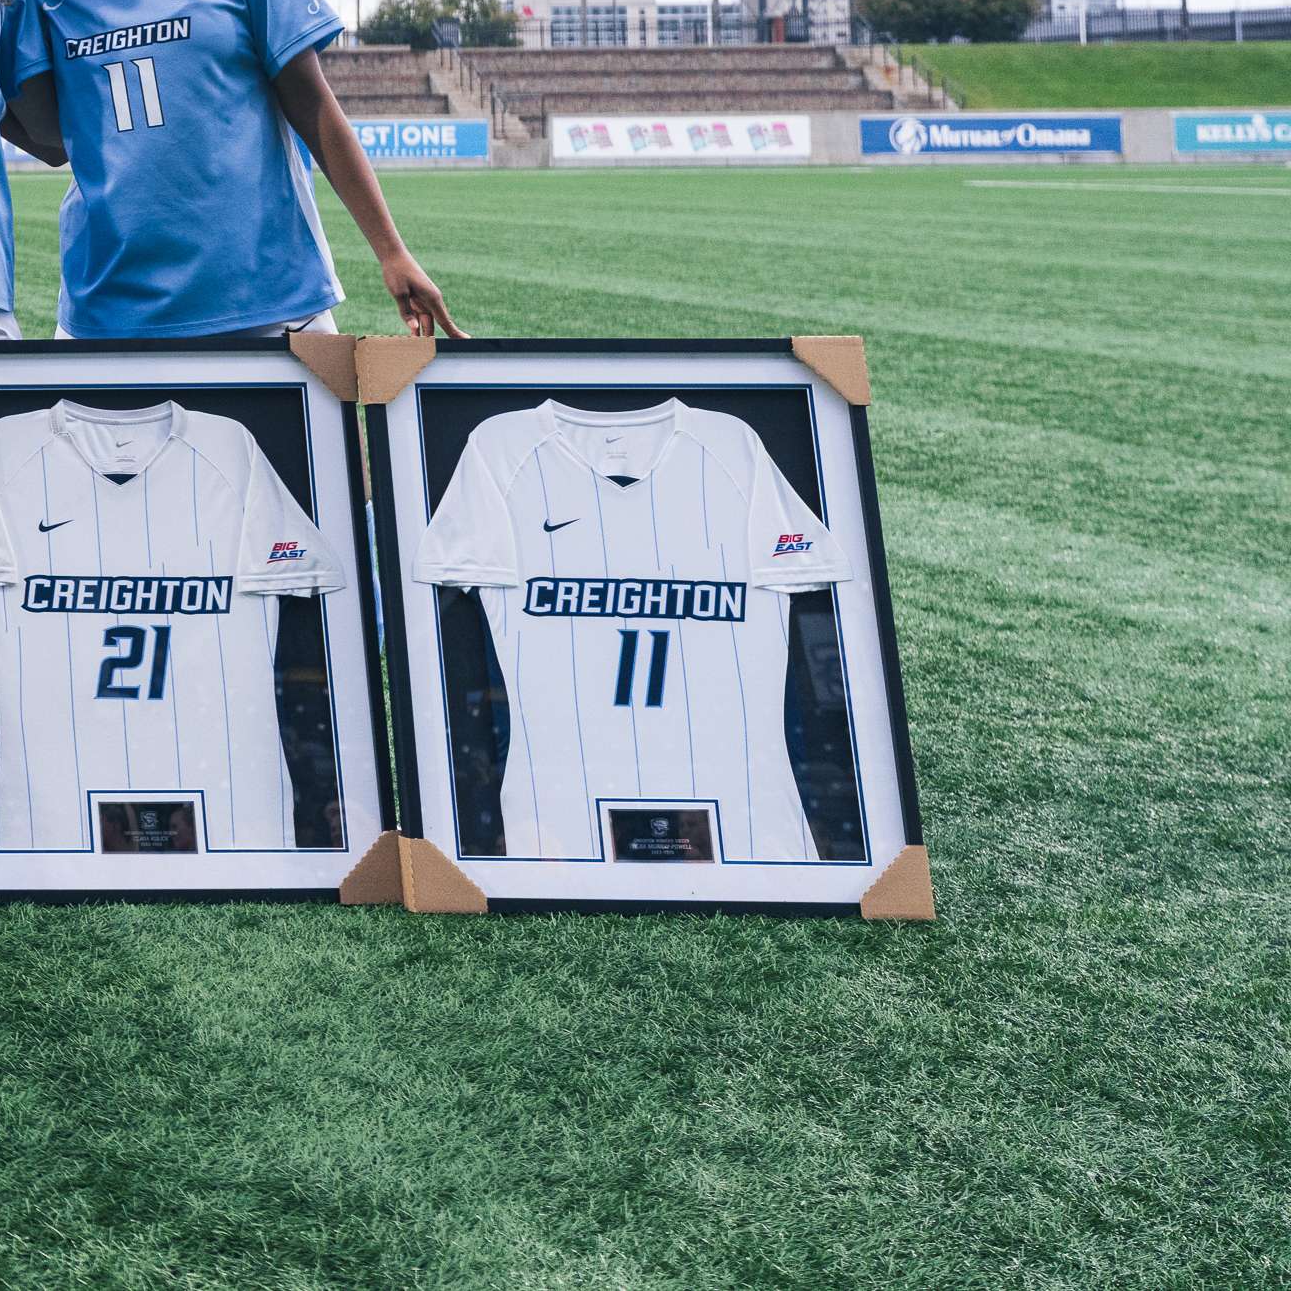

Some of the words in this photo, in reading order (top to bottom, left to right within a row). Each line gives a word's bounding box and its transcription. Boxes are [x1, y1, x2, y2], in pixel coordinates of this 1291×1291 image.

[65, 17, 191, 60] CREIGHTON
[102, 57, 165, 133] 11
[402, 125, 457, 146] ONE
[269, 549, 307, 559] EAST
[272, 541, 298, 551] BIG
[774, 541, 814, 552] EAST
[778, 534, 804, 543] BIG
[21, 575, 234, 614] CREIGHTON
[523, 576, 747, 622] CREIGHTON
[94, 624, 171, 701] 21
[613, 628, 670, 708] 11
